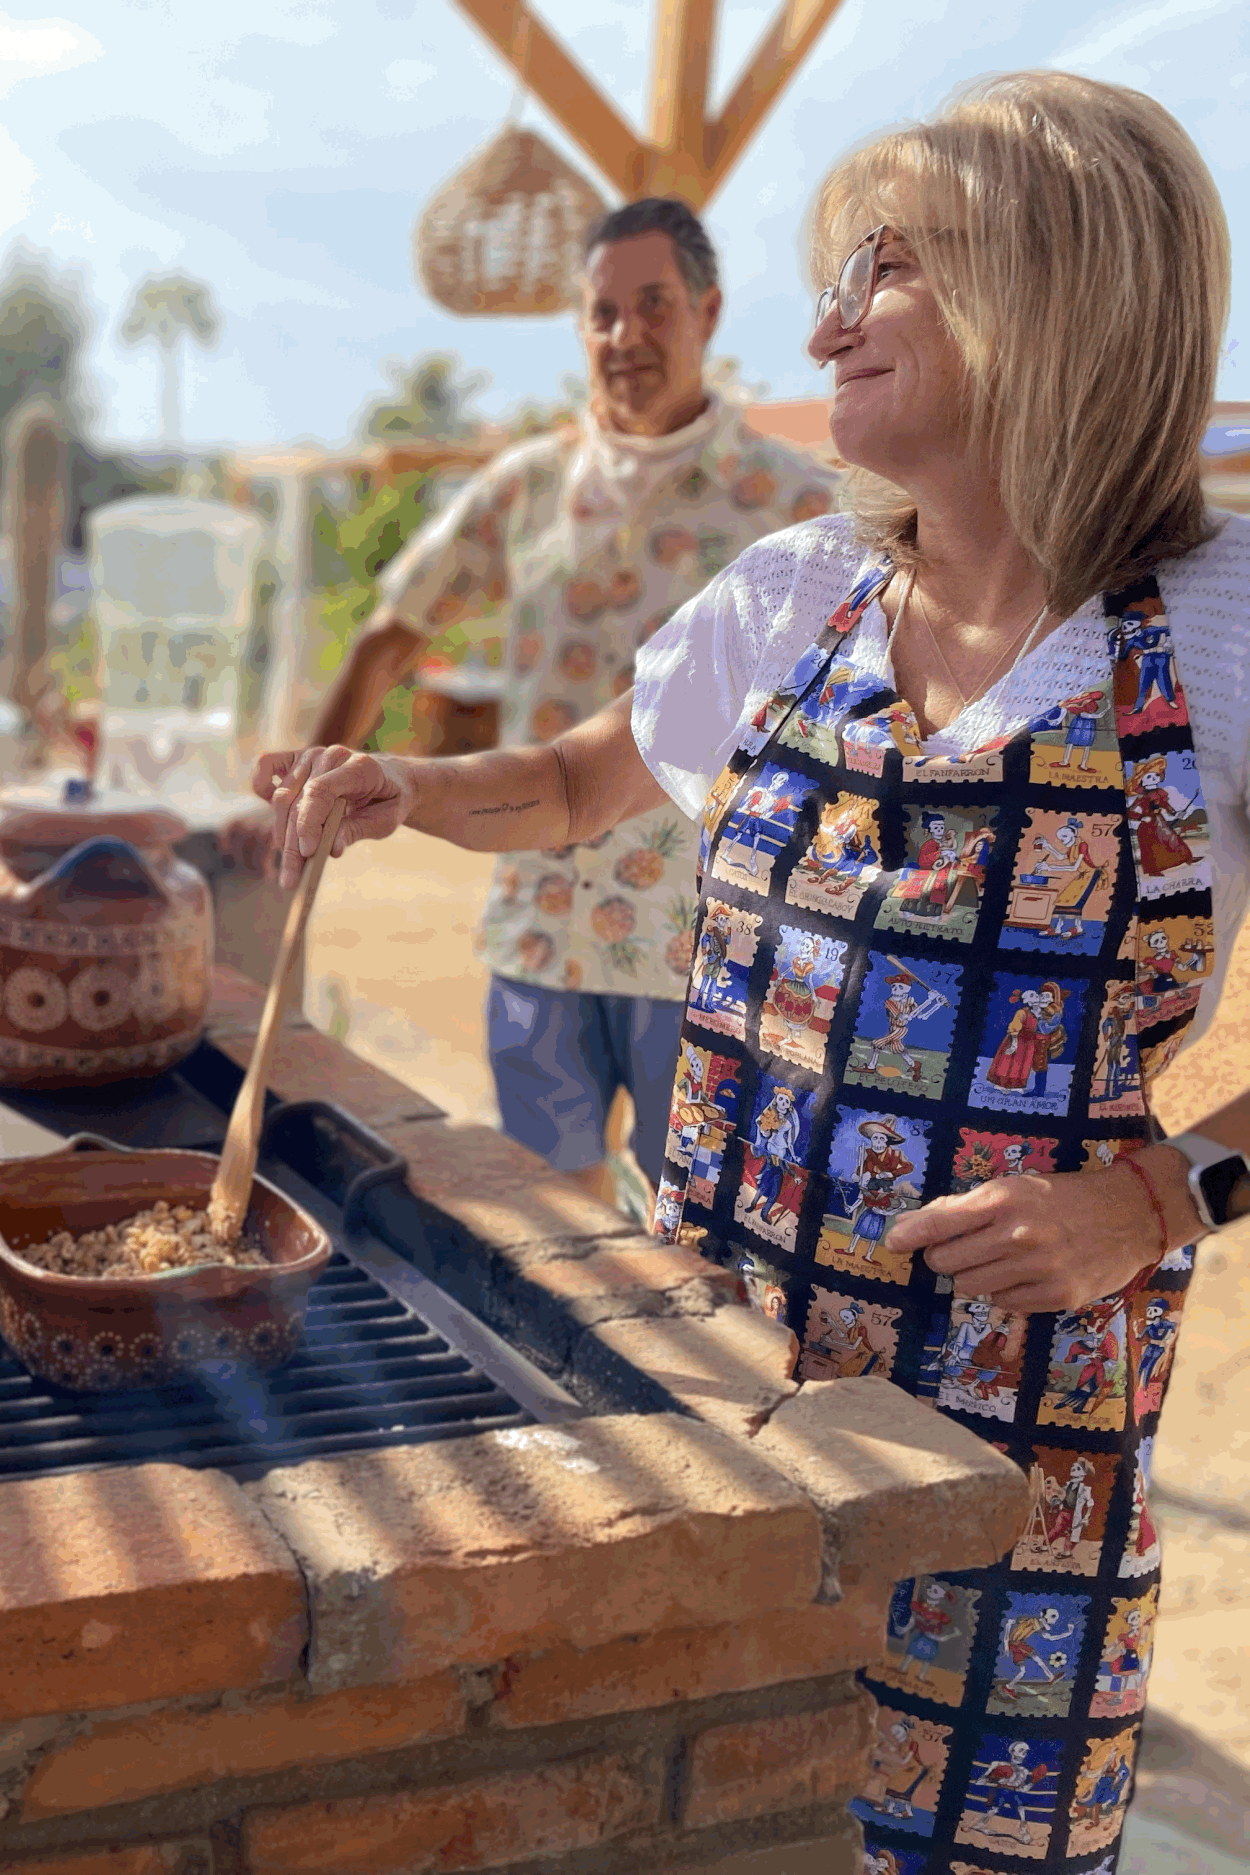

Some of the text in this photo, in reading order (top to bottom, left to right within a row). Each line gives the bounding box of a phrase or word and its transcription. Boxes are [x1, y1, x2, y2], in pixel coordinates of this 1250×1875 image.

[929, 768, 990, 778] FANFARRON
[1091, 823, 1115, 838] 57
[1146, 877, 1203, 895] LA CHARRA
[735, 920, 752, 936] 38
[871, 1311, 892, 1327] 57
